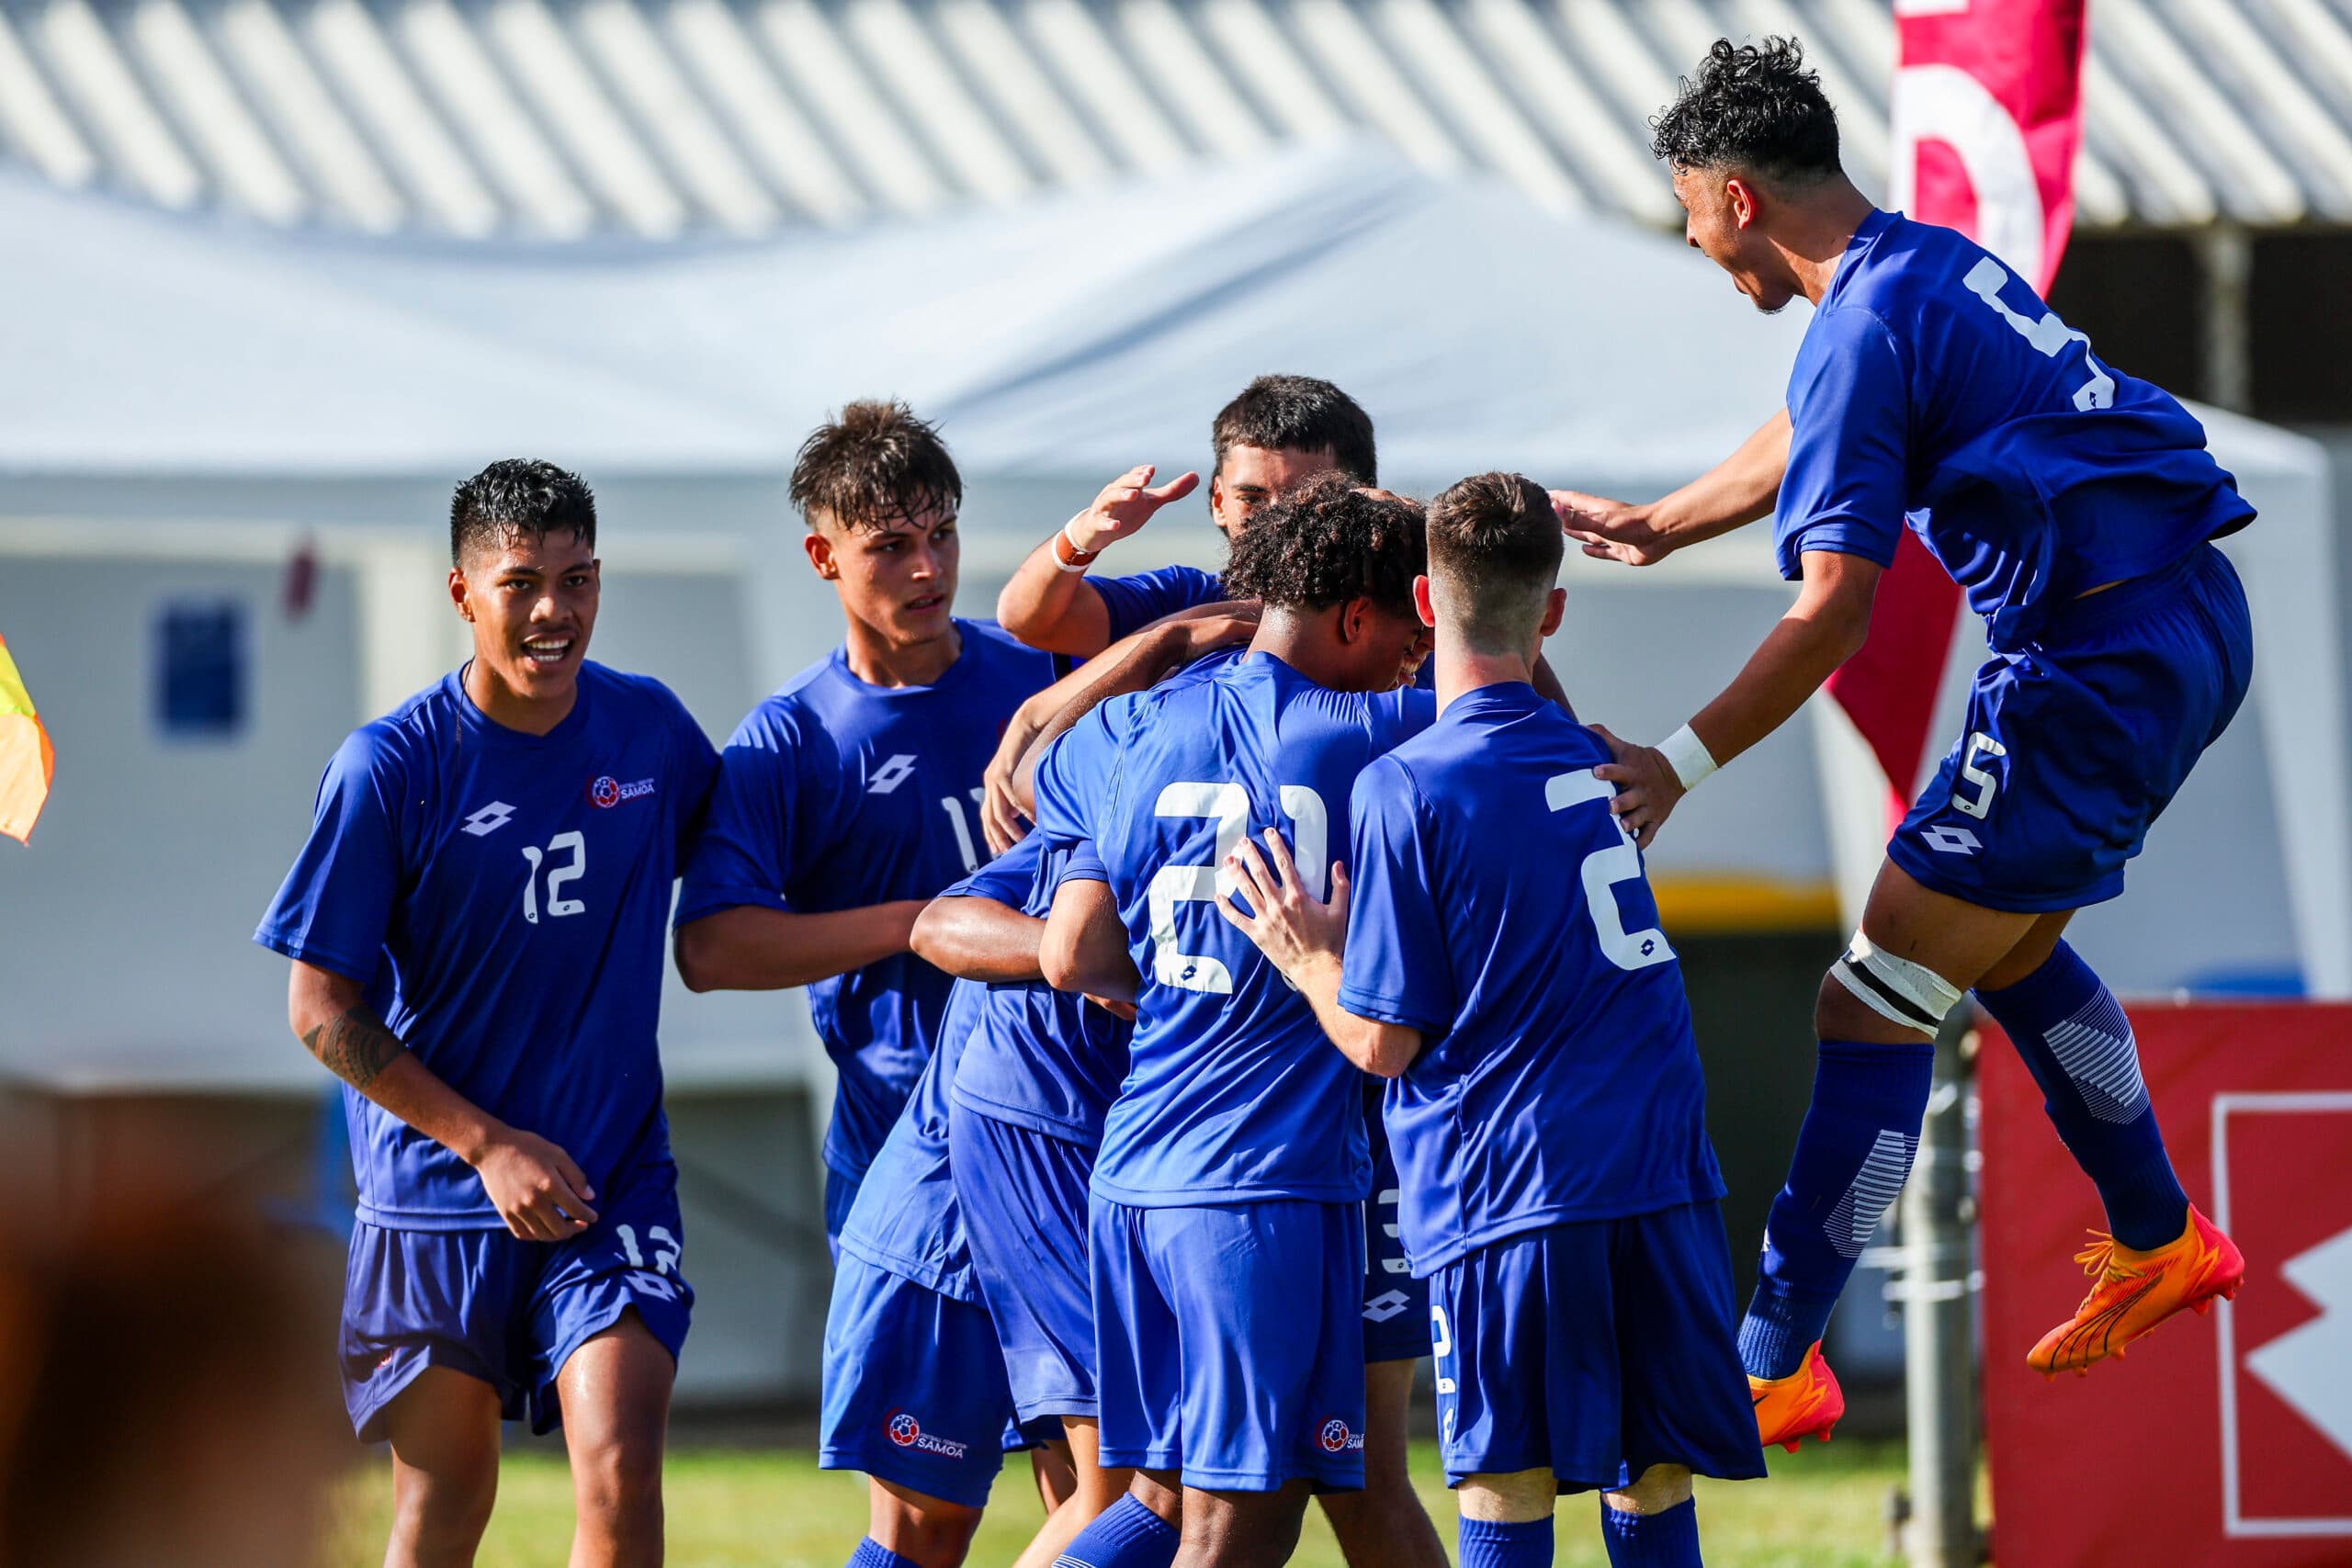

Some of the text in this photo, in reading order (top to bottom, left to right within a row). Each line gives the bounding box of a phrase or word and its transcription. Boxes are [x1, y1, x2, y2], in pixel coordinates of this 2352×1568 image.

[1962, 255, 2114, 412] 5
[620, 784, 655, 800] SAMOA
[1951, 731, 2007, 820] 5
[522, 830, 586, 924] 12
[1148, 781, 1328, 994] 21
[1544, 768, 1677, 971] 2
[616, 1224, 682, 1276] 12
[918, 1438, 964, 1459] SAMOA
